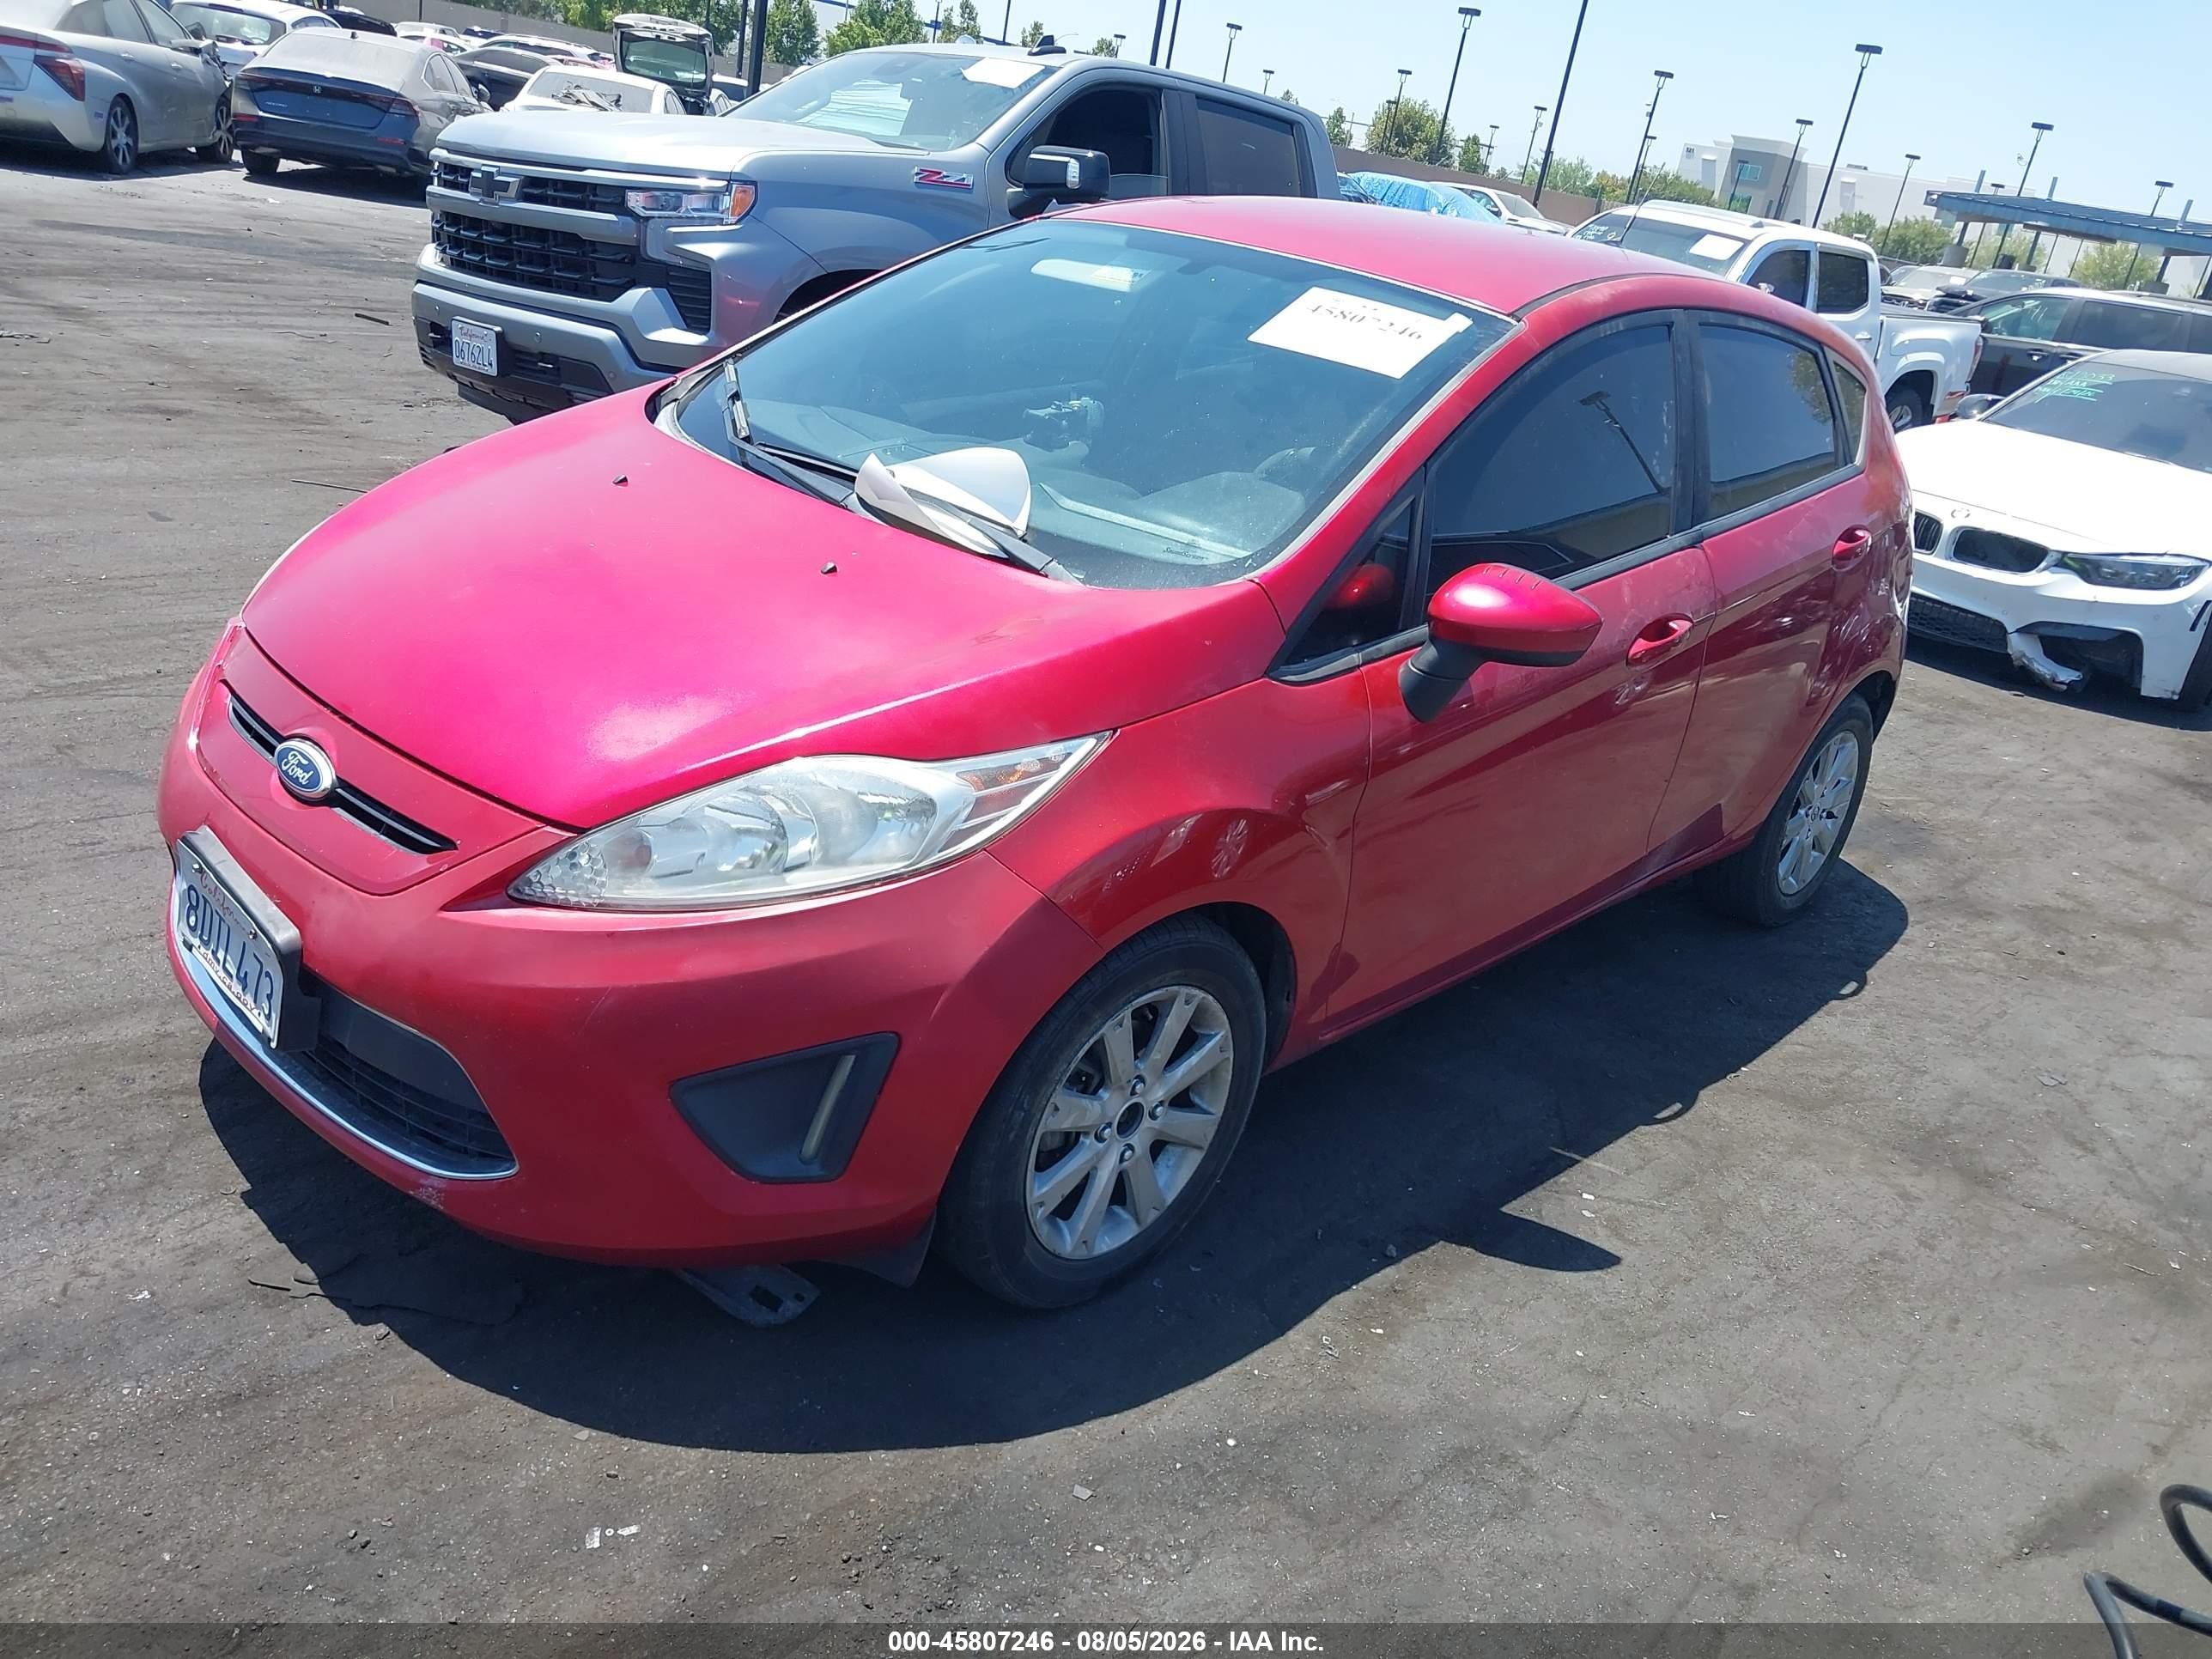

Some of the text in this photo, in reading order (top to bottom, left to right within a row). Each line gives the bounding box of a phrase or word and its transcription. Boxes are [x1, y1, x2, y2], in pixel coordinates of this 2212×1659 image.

[914, 166, 974, 189] Z71
[454, 337, 493, 368] 06762L4
[281, 750, 314, 785] Ford
[185, 884, 274, 1022] 8DIL473
[202, 950, 256, 1013] dmv.ca.gov
